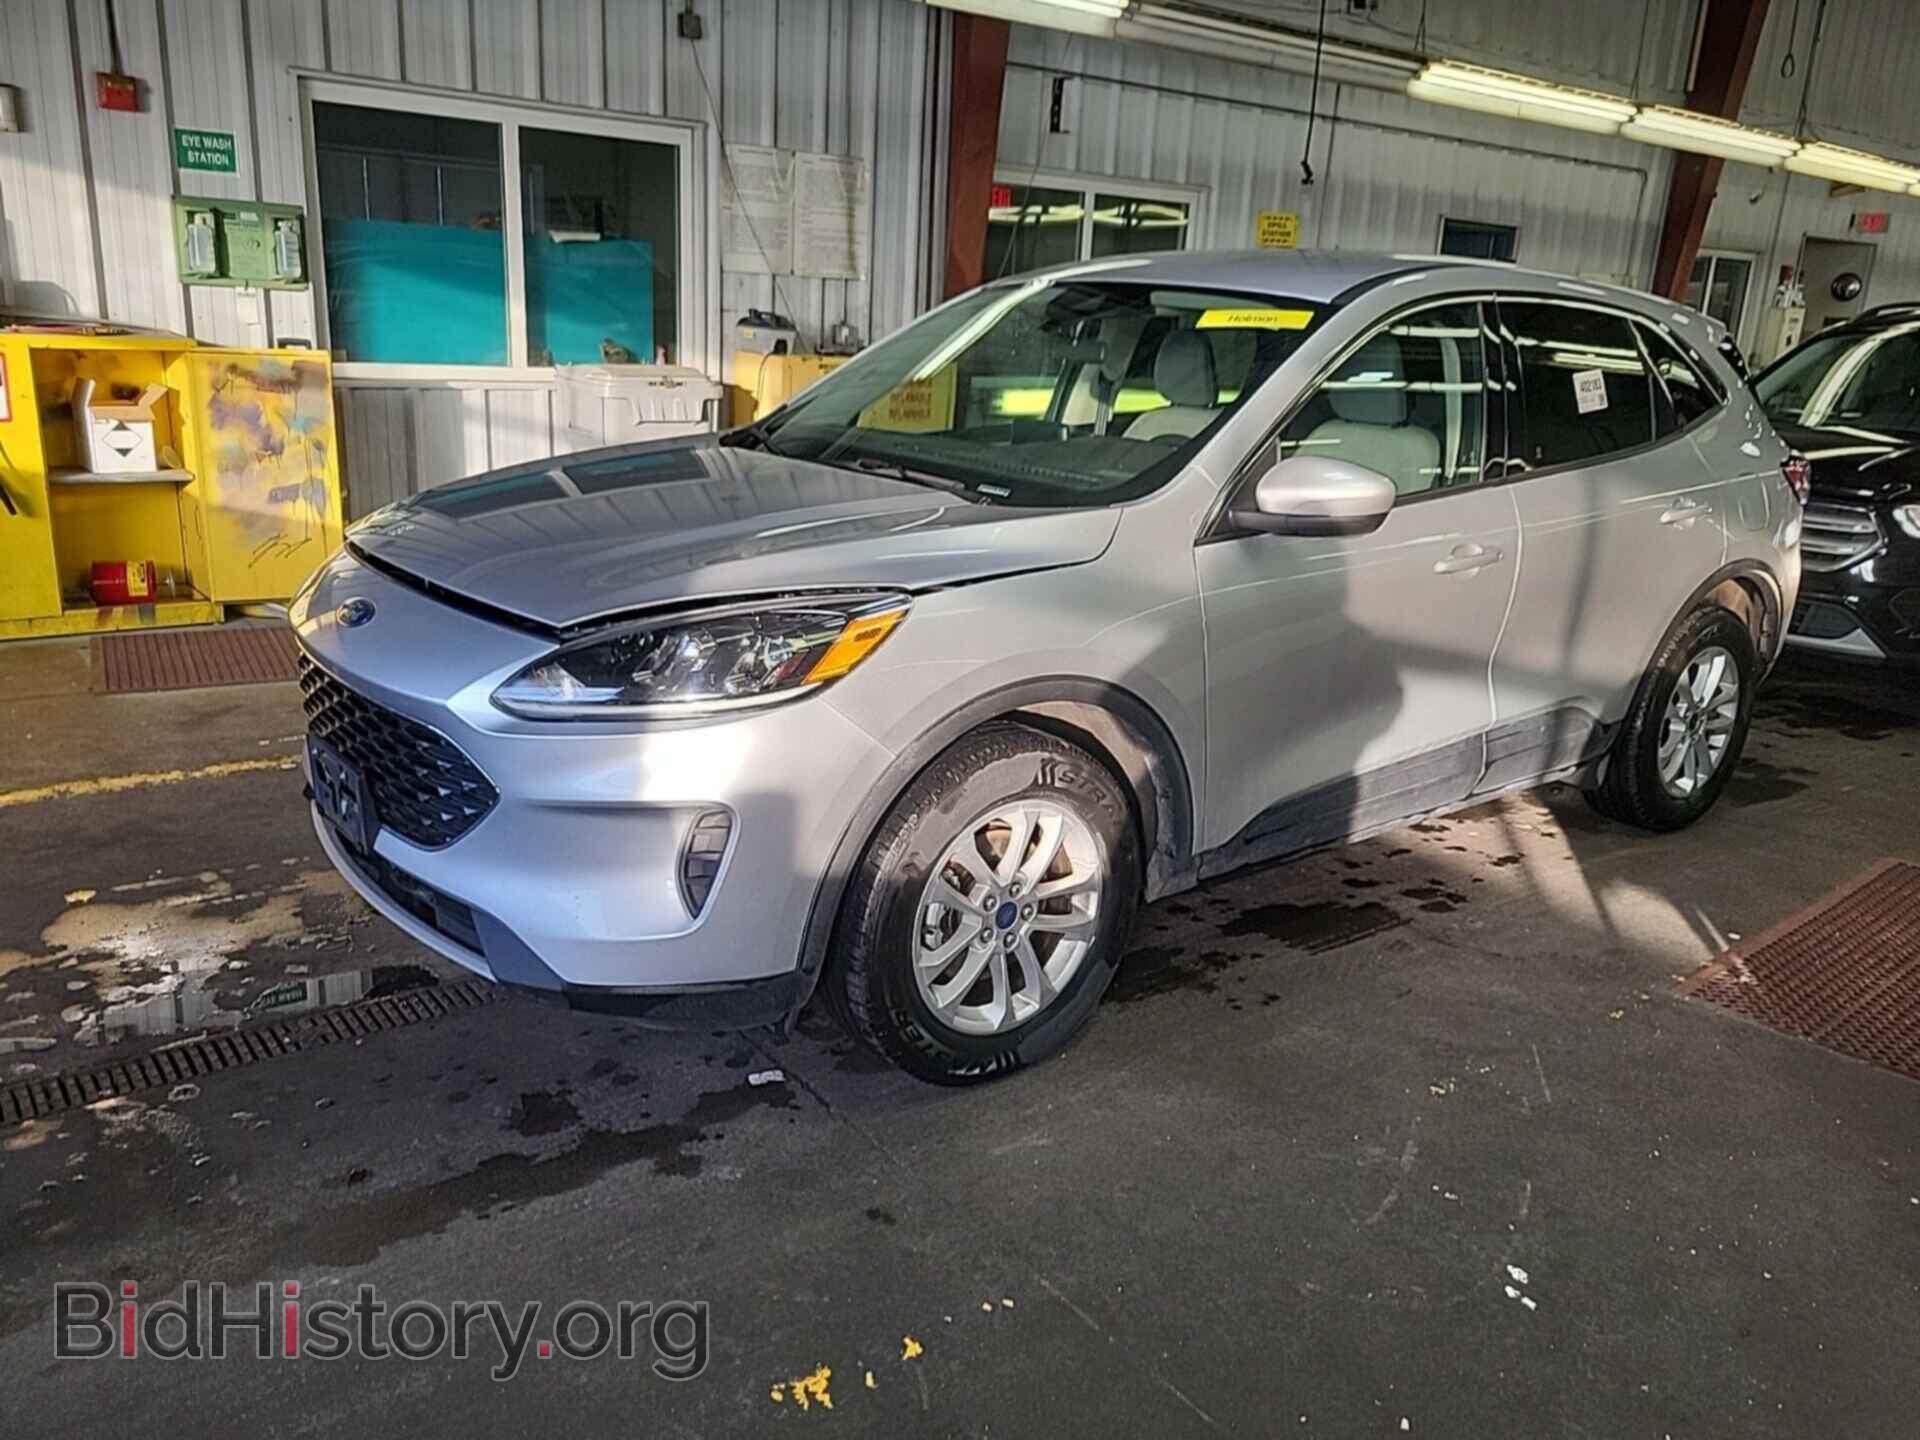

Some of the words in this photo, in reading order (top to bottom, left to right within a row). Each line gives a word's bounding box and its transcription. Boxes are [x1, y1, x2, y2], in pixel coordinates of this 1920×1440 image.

[181, 134, 200, 148] EYE
[202, 136, 232, 150] WASH
[187, 150, 229, 165] STATION
